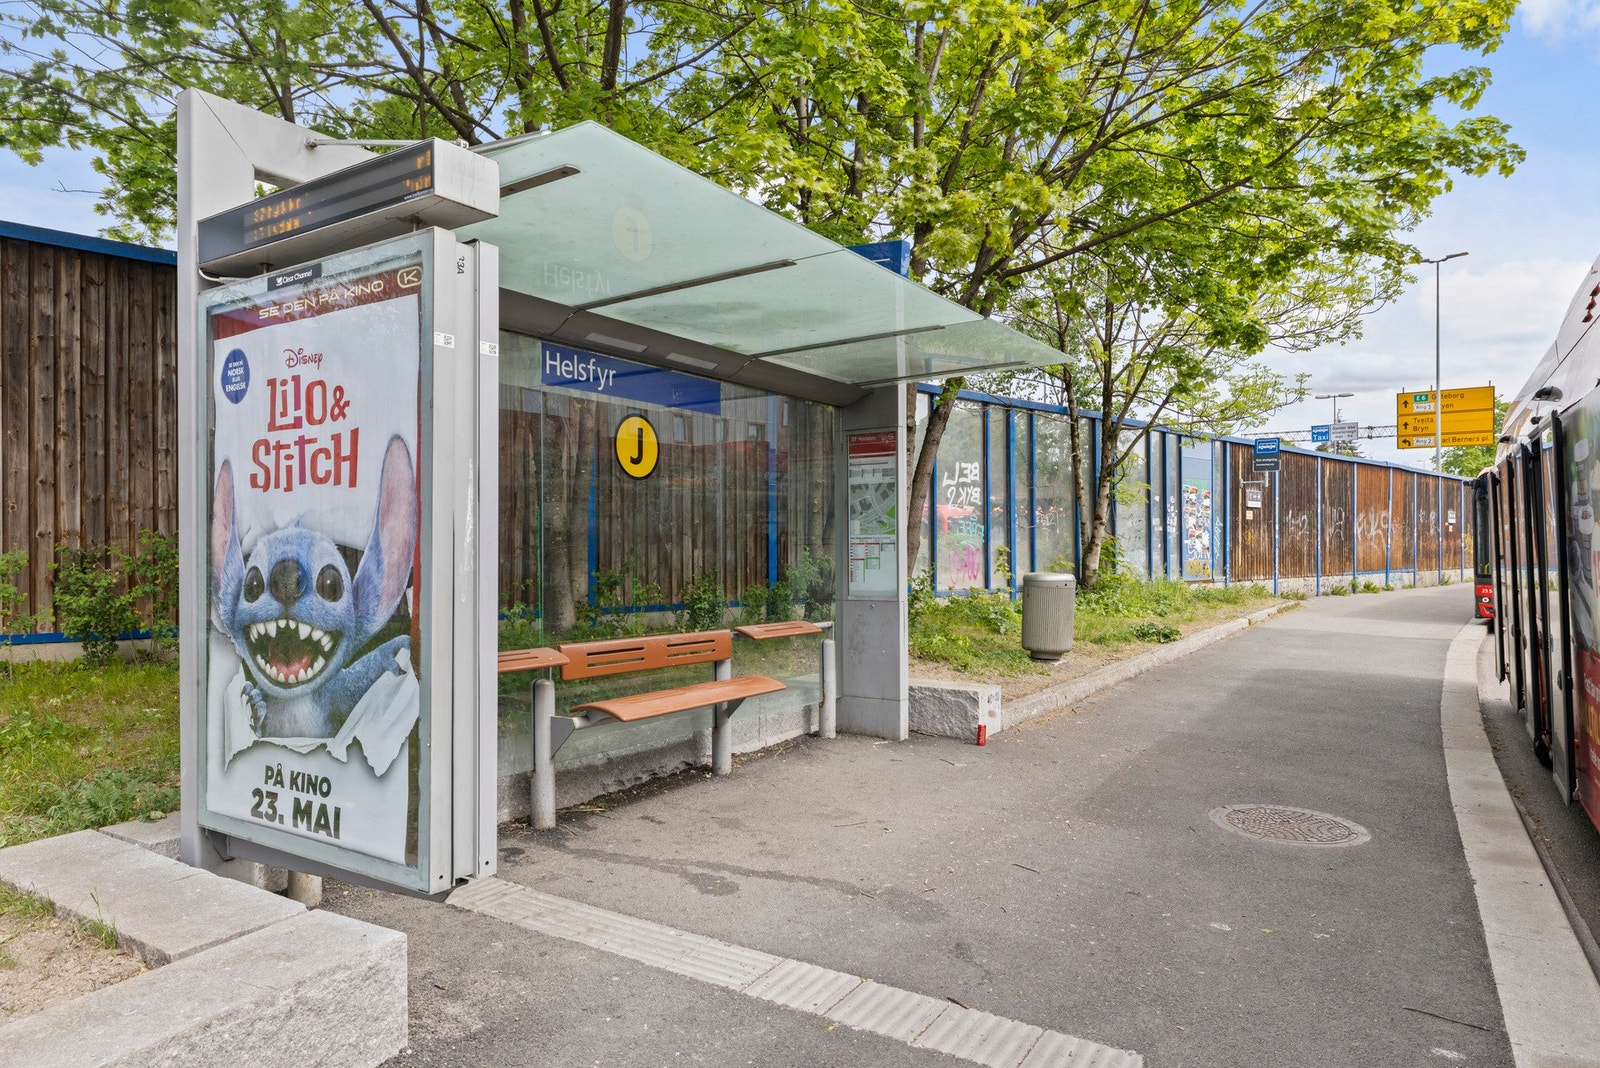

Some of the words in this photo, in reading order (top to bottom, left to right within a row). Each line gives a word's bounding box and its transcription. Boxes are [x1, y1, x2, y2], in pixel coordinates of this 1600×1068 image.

[283, 275, 294, 284] Clear
[294, 270, 312, 281] Channel
[258, 306, 280, 319] SE
[283, 299, 316, 314] DEN
[319, 288, 340, 306] PÅ
[344, 280, 384, 299] KINO
[545, 351, 616, 390] Helsfyr
[1431, 392, 1465, 400] Gteborg
[629, 427, 644, 465] J
[264, 763, 286, 789] PÅ
[289, 770, 332, 799] KINO
[250, 788, 285, 825] 23.
[292, 798, 341, 840] MAI
